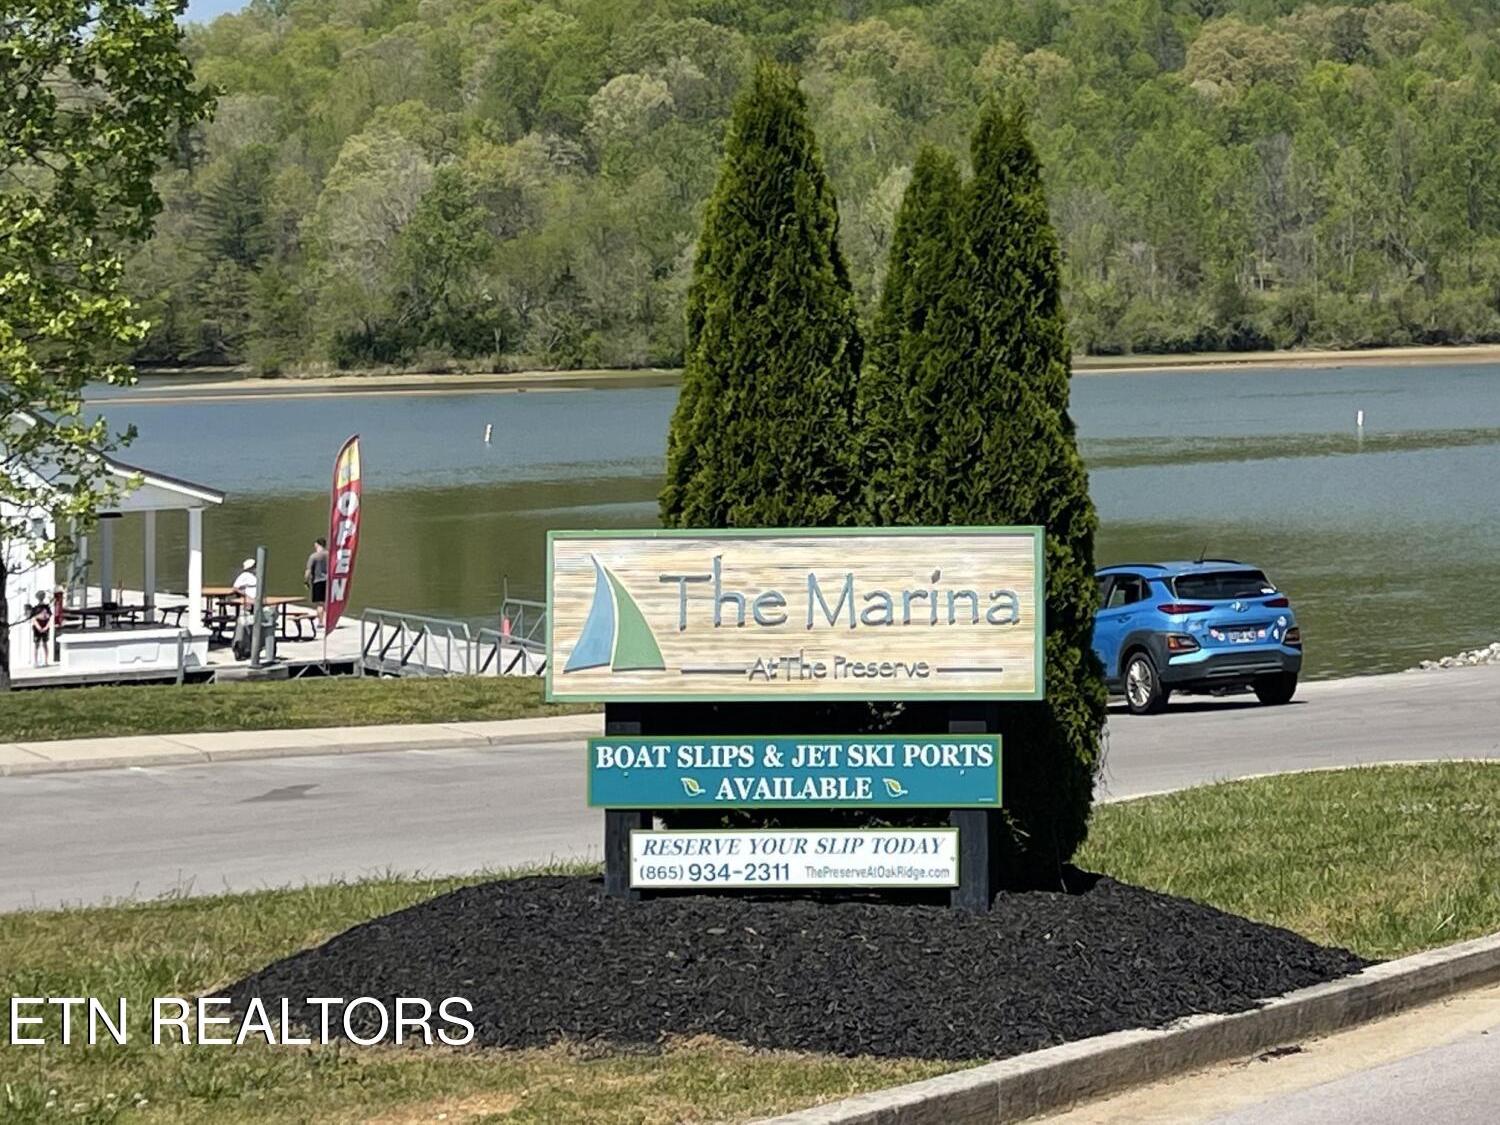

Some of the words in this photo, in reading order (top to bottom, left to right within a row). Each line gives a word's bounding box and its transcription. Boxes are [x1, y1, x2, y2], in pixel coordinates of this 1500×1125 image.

[330, 491, 360, 602] OPEN
[659, 554, 788, 632] The
[806, 565, 1021, 630] Marina
[749, 657, 778, 681] At
[779, 648, 827, 681] The
[833, 655, 930, 679] Preserve
[596, 745, 671, 769] BOAT
[677, 745, 754, 768] SLIPS
[763, 744, 785, 768] &
[791, 744, 843, 768] JET
[847, 744, 895, 767] SKI
[903, 744, 994, 767] PORTS
[715, 777, 873, 800] AVAILABLE
[642, 838, 742, 856] RESERVE
[750, 837, 808, 856] YOUR
[814, 837, 864, 855] SLIP
[871, 837, 946, 855] TODAY
[640, 864, 684, 881] (865)
[688, 863, 790, 882] 934-2311
[805, 865, 950, 881] ThePreserveAtOakRidge.com
